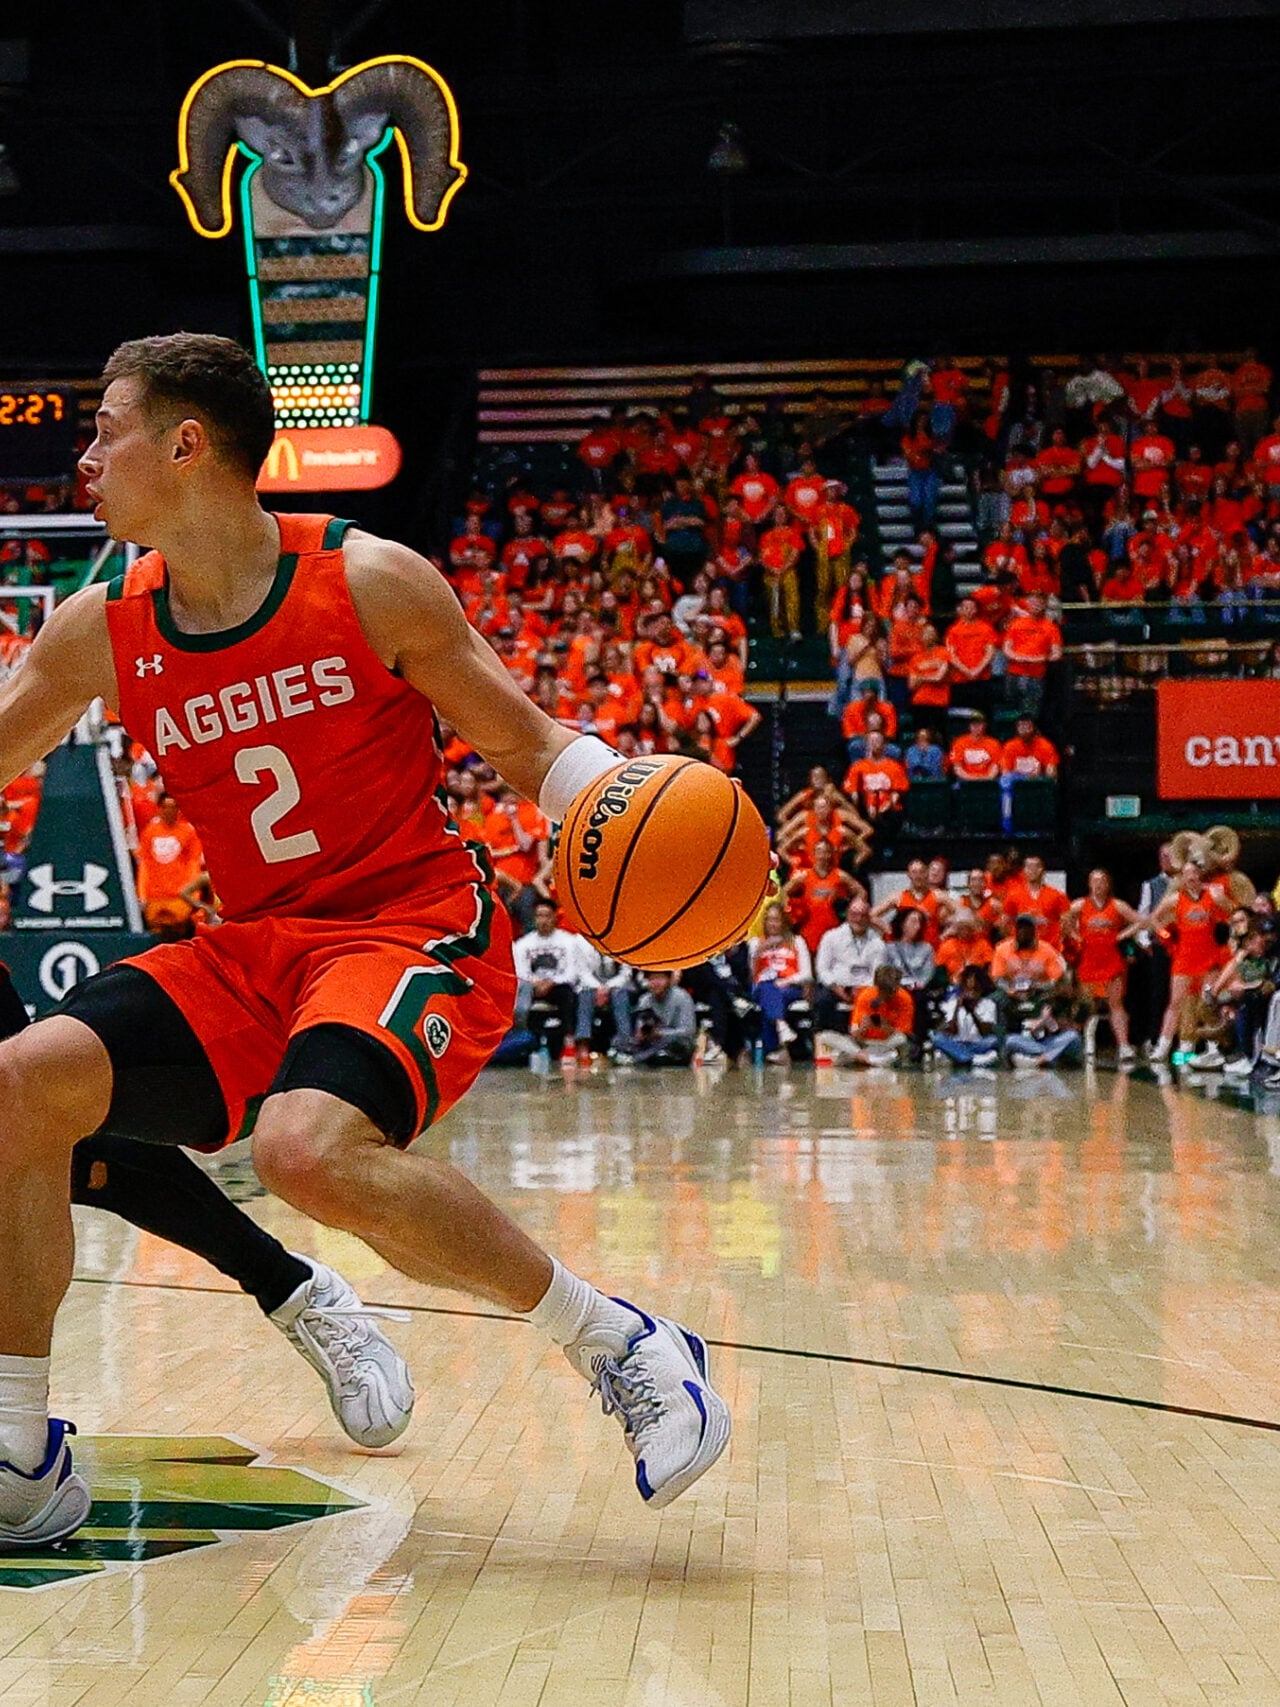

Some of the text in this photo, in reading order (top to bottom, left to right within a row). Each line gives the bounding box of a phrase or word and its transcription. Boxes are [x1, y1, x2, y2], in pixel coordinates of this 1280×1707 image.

[155, 656, 355, 756] AGGIES
[1184, 735, 1280, 767] can
[234, 744, 321, 864] 2
[578, 761, 666, 880] Wilson
